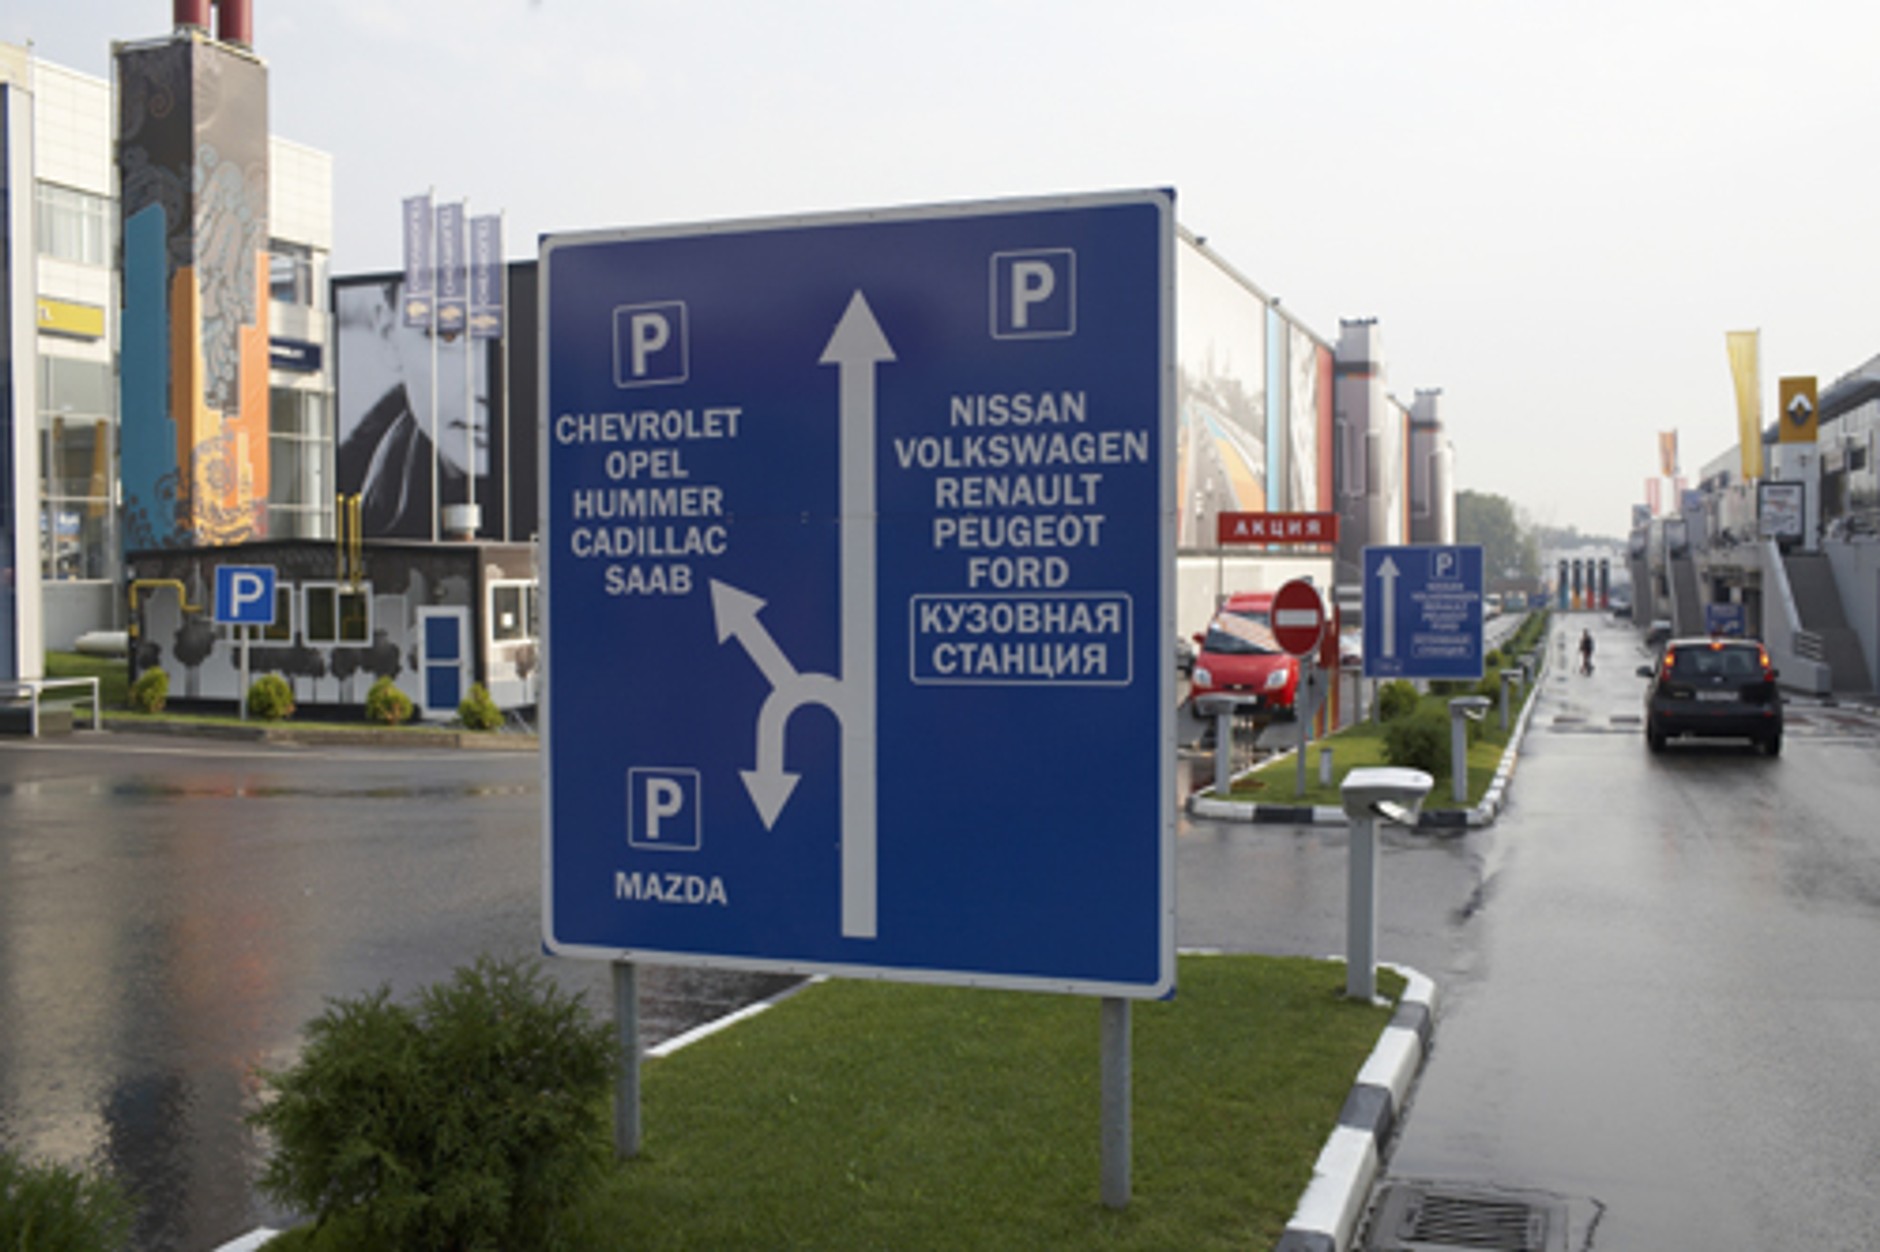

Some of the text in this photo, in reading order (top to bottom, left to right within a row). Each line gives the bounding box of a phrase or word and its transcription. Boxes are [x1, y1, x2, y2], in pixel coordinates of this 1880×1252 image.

[1012, 261, 1055, 328] P
[631, 312, 670, 375] P
[555, 407, 742, 444] CHEVROLET
[951, 391, 1085, 426] NISSAN
[605, 449, 689, 480] OPEL
[894, 431, 1148, 468] VOLKSWAGEN
[574, 486, 723, 518] HUMMER
[936, 473, 1102, 508] RENAULT
[571, 525, 727, 557] CADILLAC
[934, 514, 1105, 548] PEUGEOT
[1234, 519, 1321, 538] АКЦИЯ
[605, 564, 692, 595] SAAB
[969, 556, 1069, 588] FORD
[1437, 553, 1453, 577] P
[230, 572, 264, 618] P
[921, 602, 1120, 634] КУЗОВНАЯ
[932, 642, 1107, 678] СТАНЦИЯ
[646, 778, 683, 839] P
[615, 871, 727, 905] MAZDA
